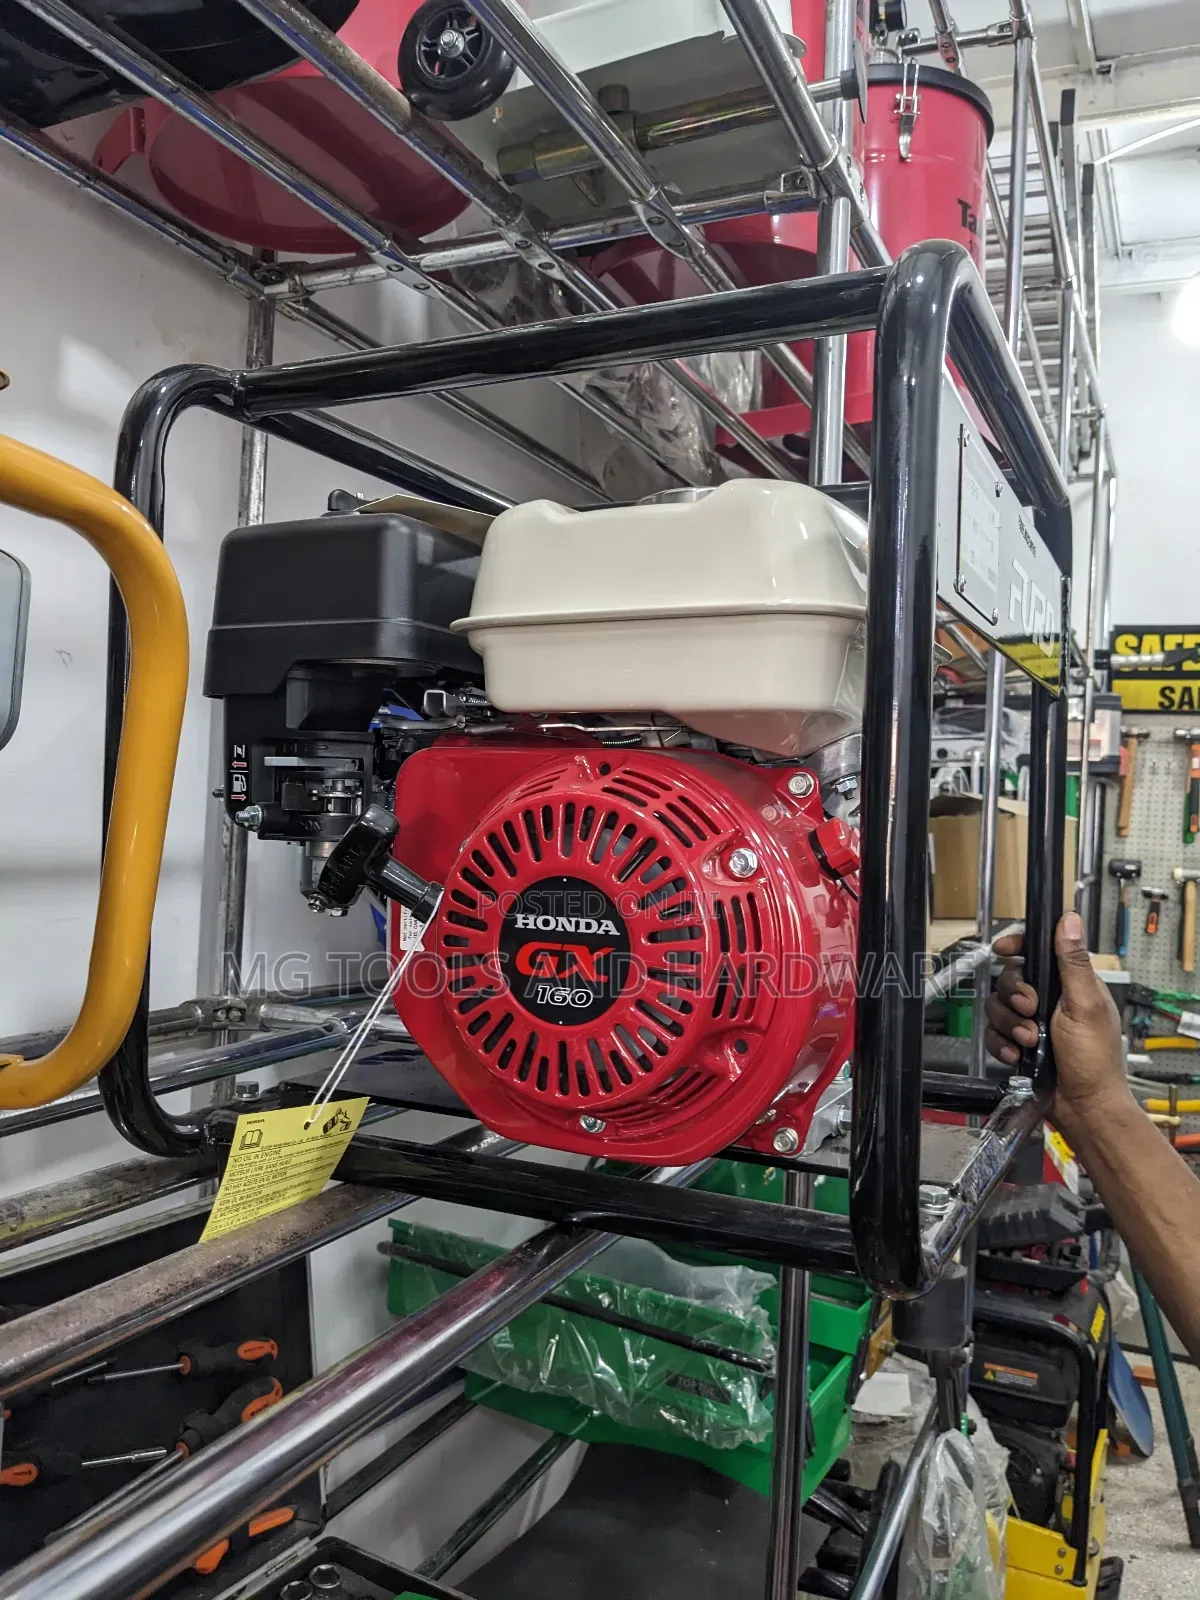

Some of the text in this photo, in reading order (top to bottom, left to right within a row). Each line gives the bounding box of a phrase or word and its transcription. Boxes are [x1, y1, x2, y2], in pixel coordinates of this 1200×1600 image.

[1158, 686, 1200, 711] SA
[514, 913, 621, 936] HONDA
[515, 941, 616, 983] GX
[537, 985, 594, 1008] 160
[260, 1149, 282, 1159] ENGINE
